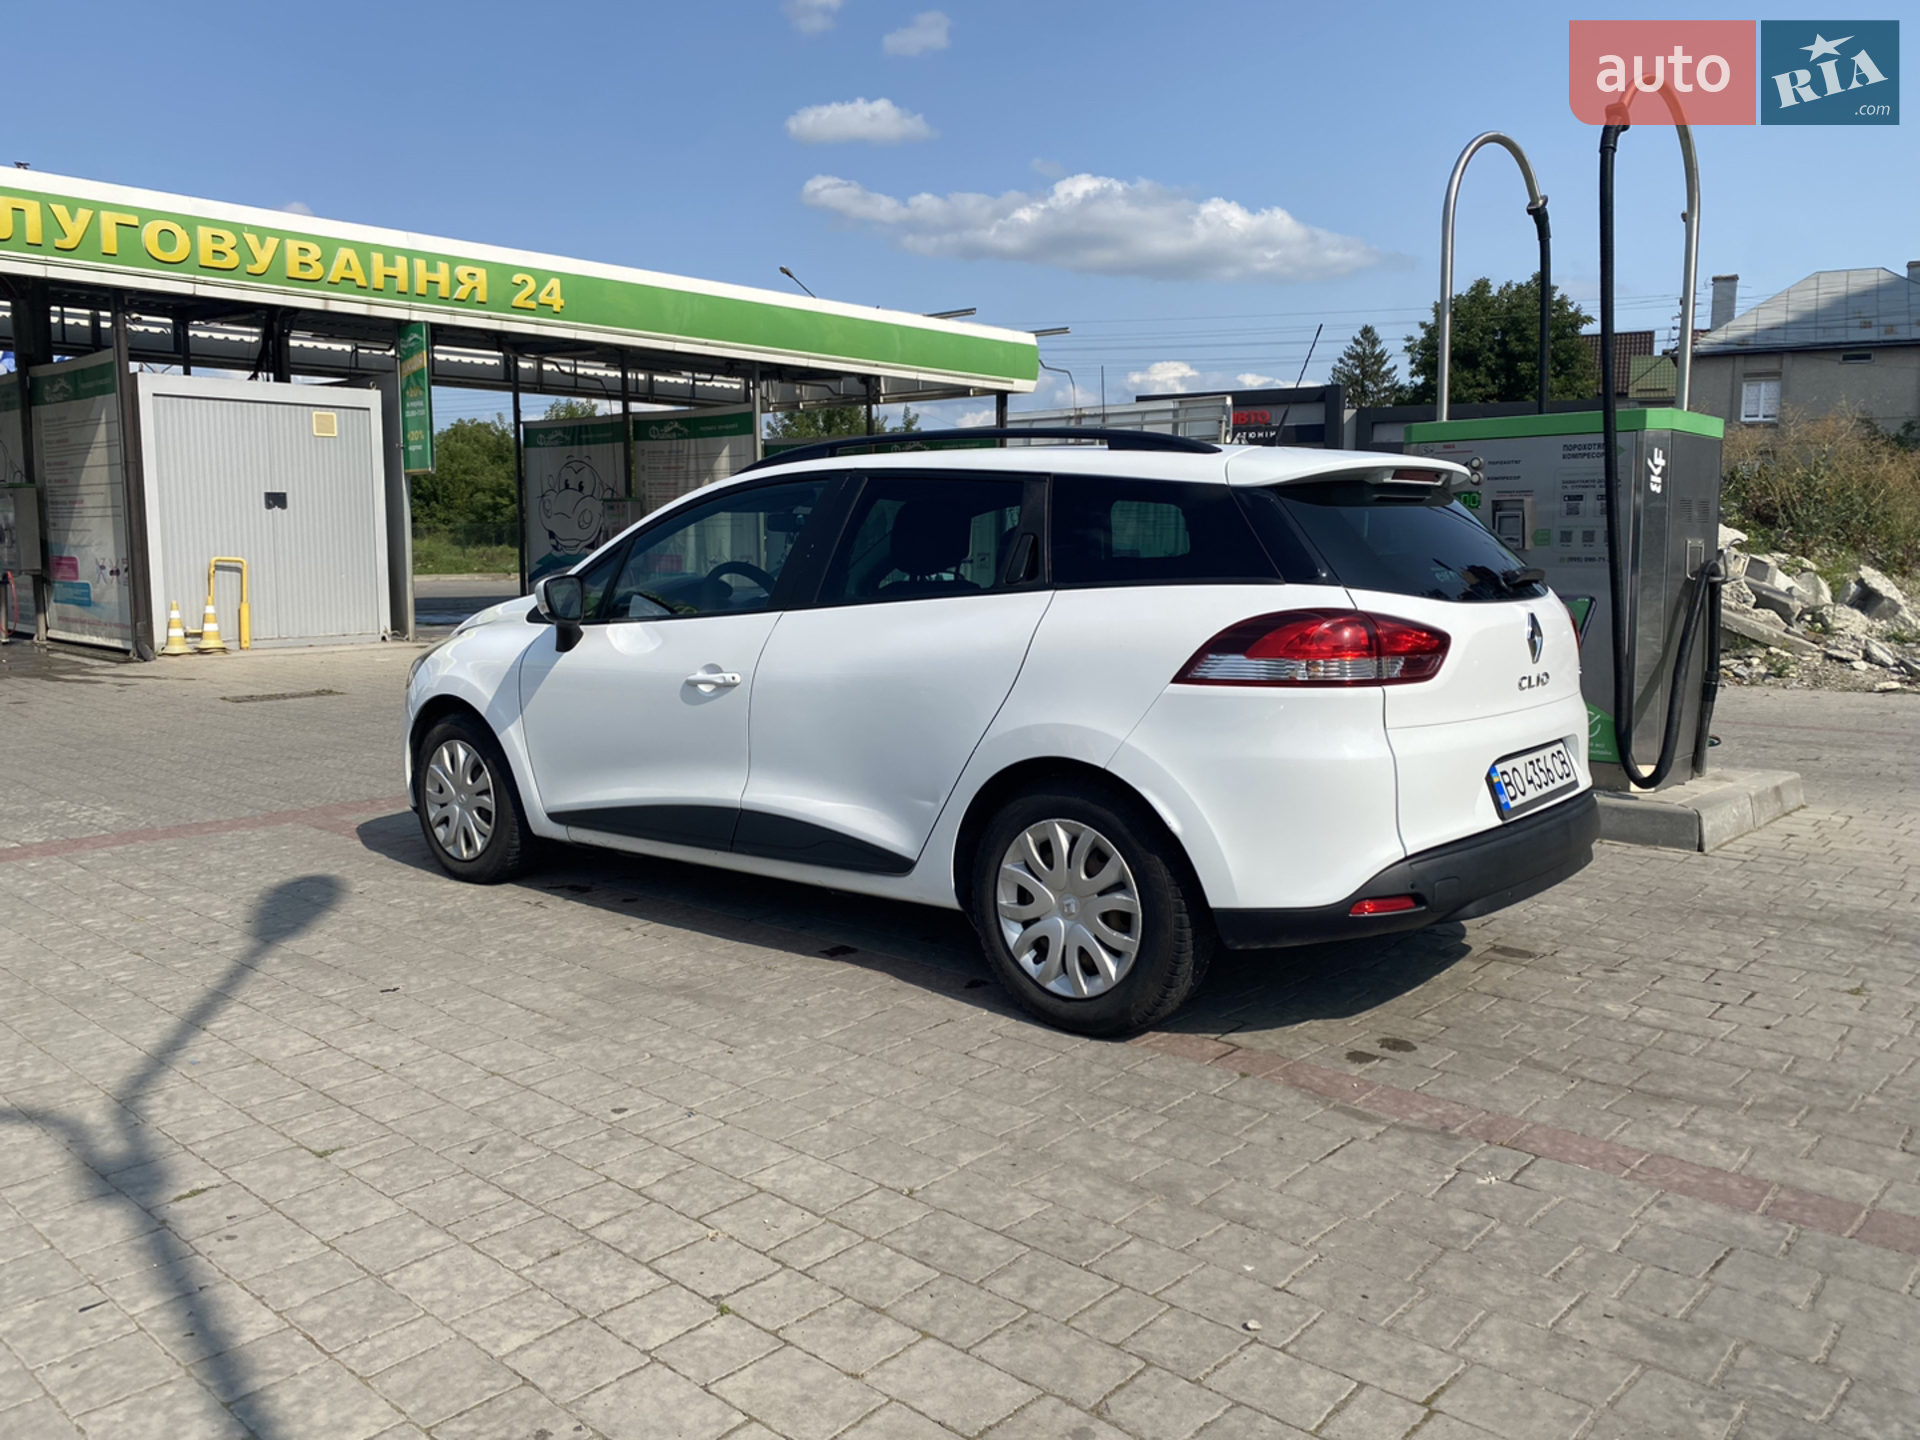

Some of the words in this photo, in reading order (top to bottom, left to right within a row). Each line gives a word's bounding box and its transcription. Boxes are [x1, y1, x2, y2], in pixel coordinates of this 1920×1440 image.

[0, 195, 488, 304] ЛУГОВУВАННЯ
[510, 273, 565, 314] 24
[1517, 671, 1550, 691] CLIO
[1500, 767, 1527, 802] BO
[1524, 755, 1556, 793] 4356
[1551, 749, 1572, 781] CB
